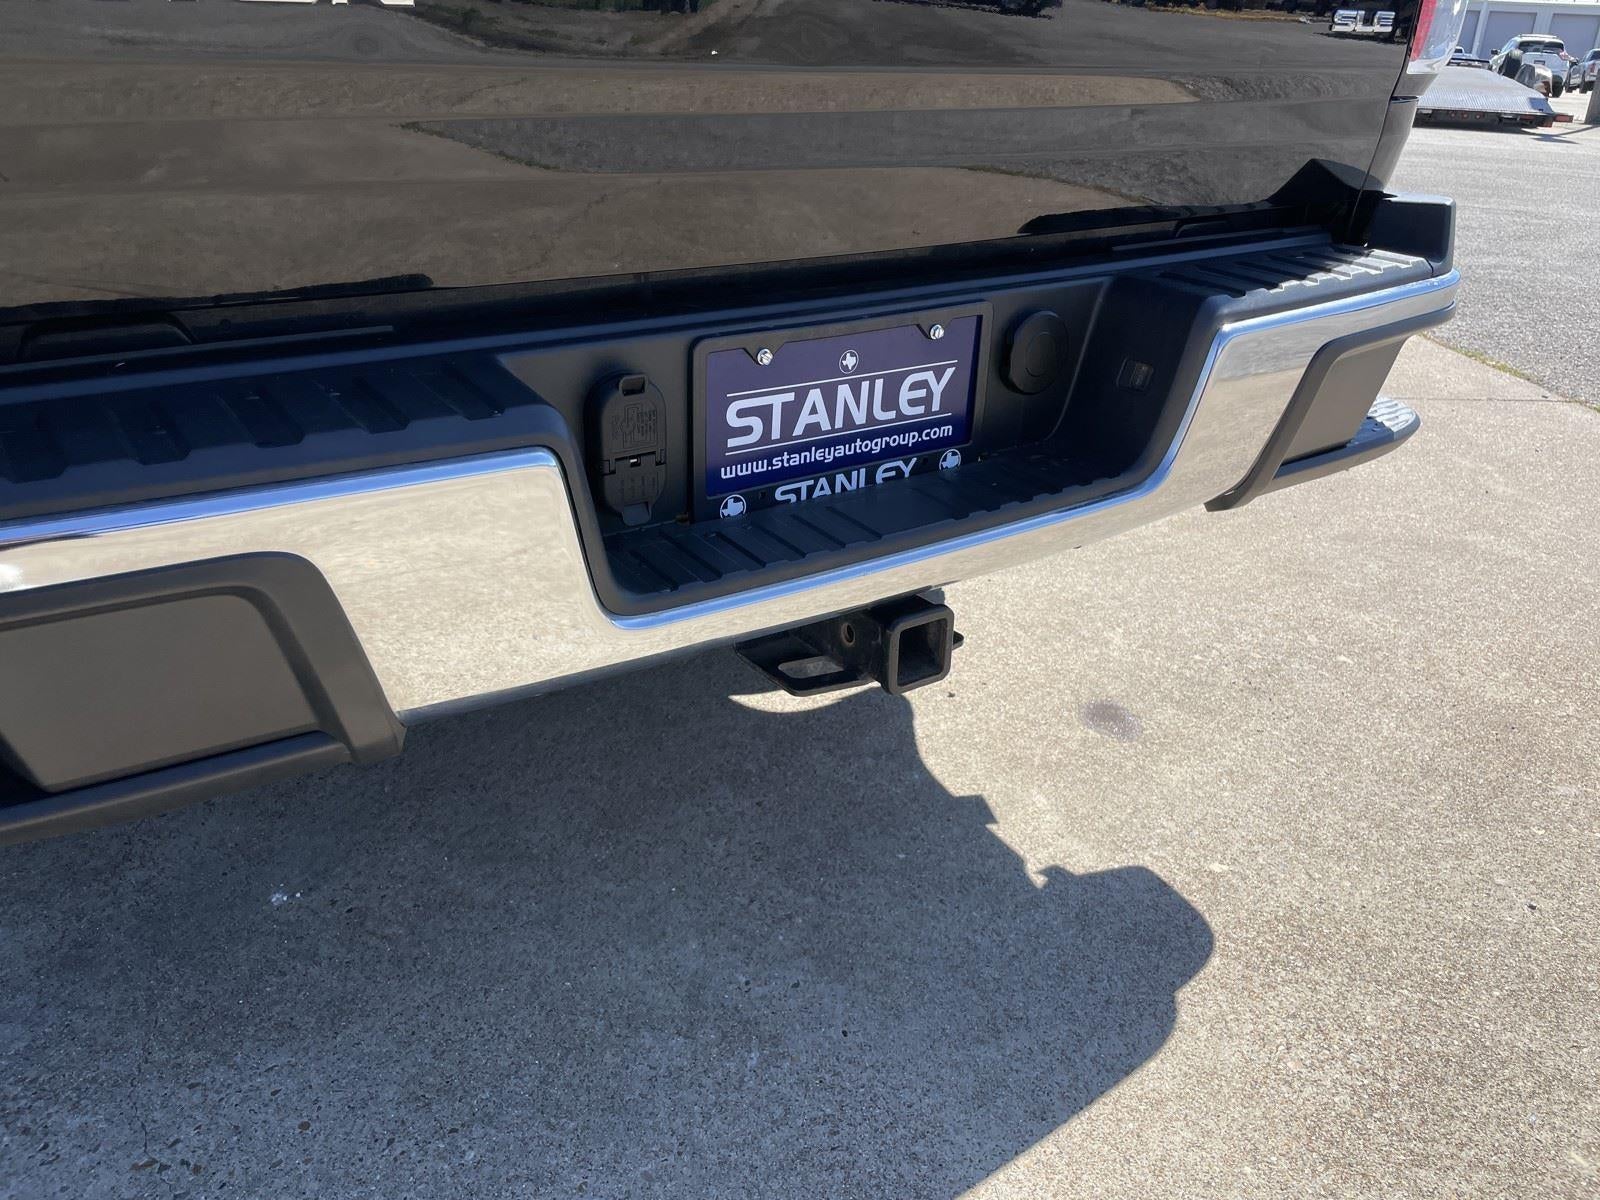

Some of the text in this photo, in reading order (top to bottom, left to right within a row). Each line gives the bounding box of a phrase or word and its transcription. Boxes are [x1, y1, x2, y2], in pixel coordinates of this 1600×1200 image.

[1331, 10, 1395, 32] SLE
[726, 367, 956, 448] STANLEY
[721, 424, 953, 480] www.stanleyautogroup.com
